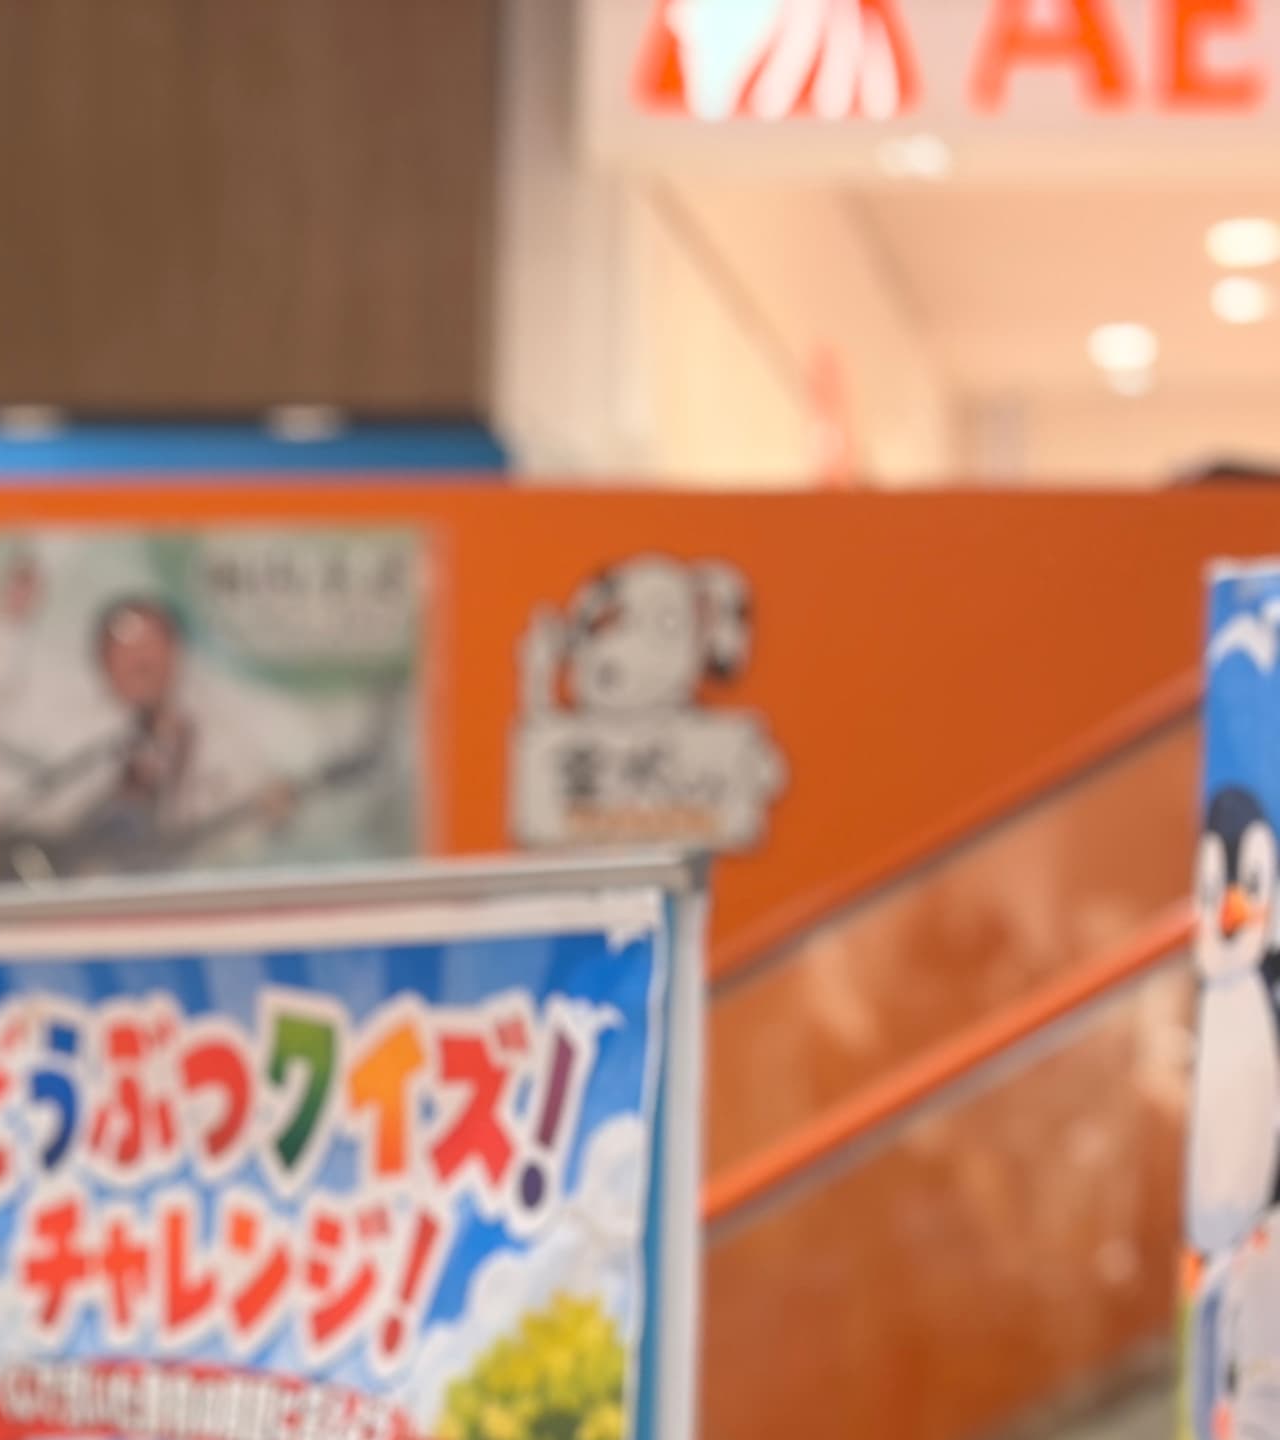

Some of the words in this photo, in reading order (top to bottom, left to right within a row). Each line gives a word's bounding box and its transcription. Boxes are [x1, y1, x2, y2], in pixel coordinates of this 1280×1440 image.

[16, 1196, 444, 1364] チャレンジ！
